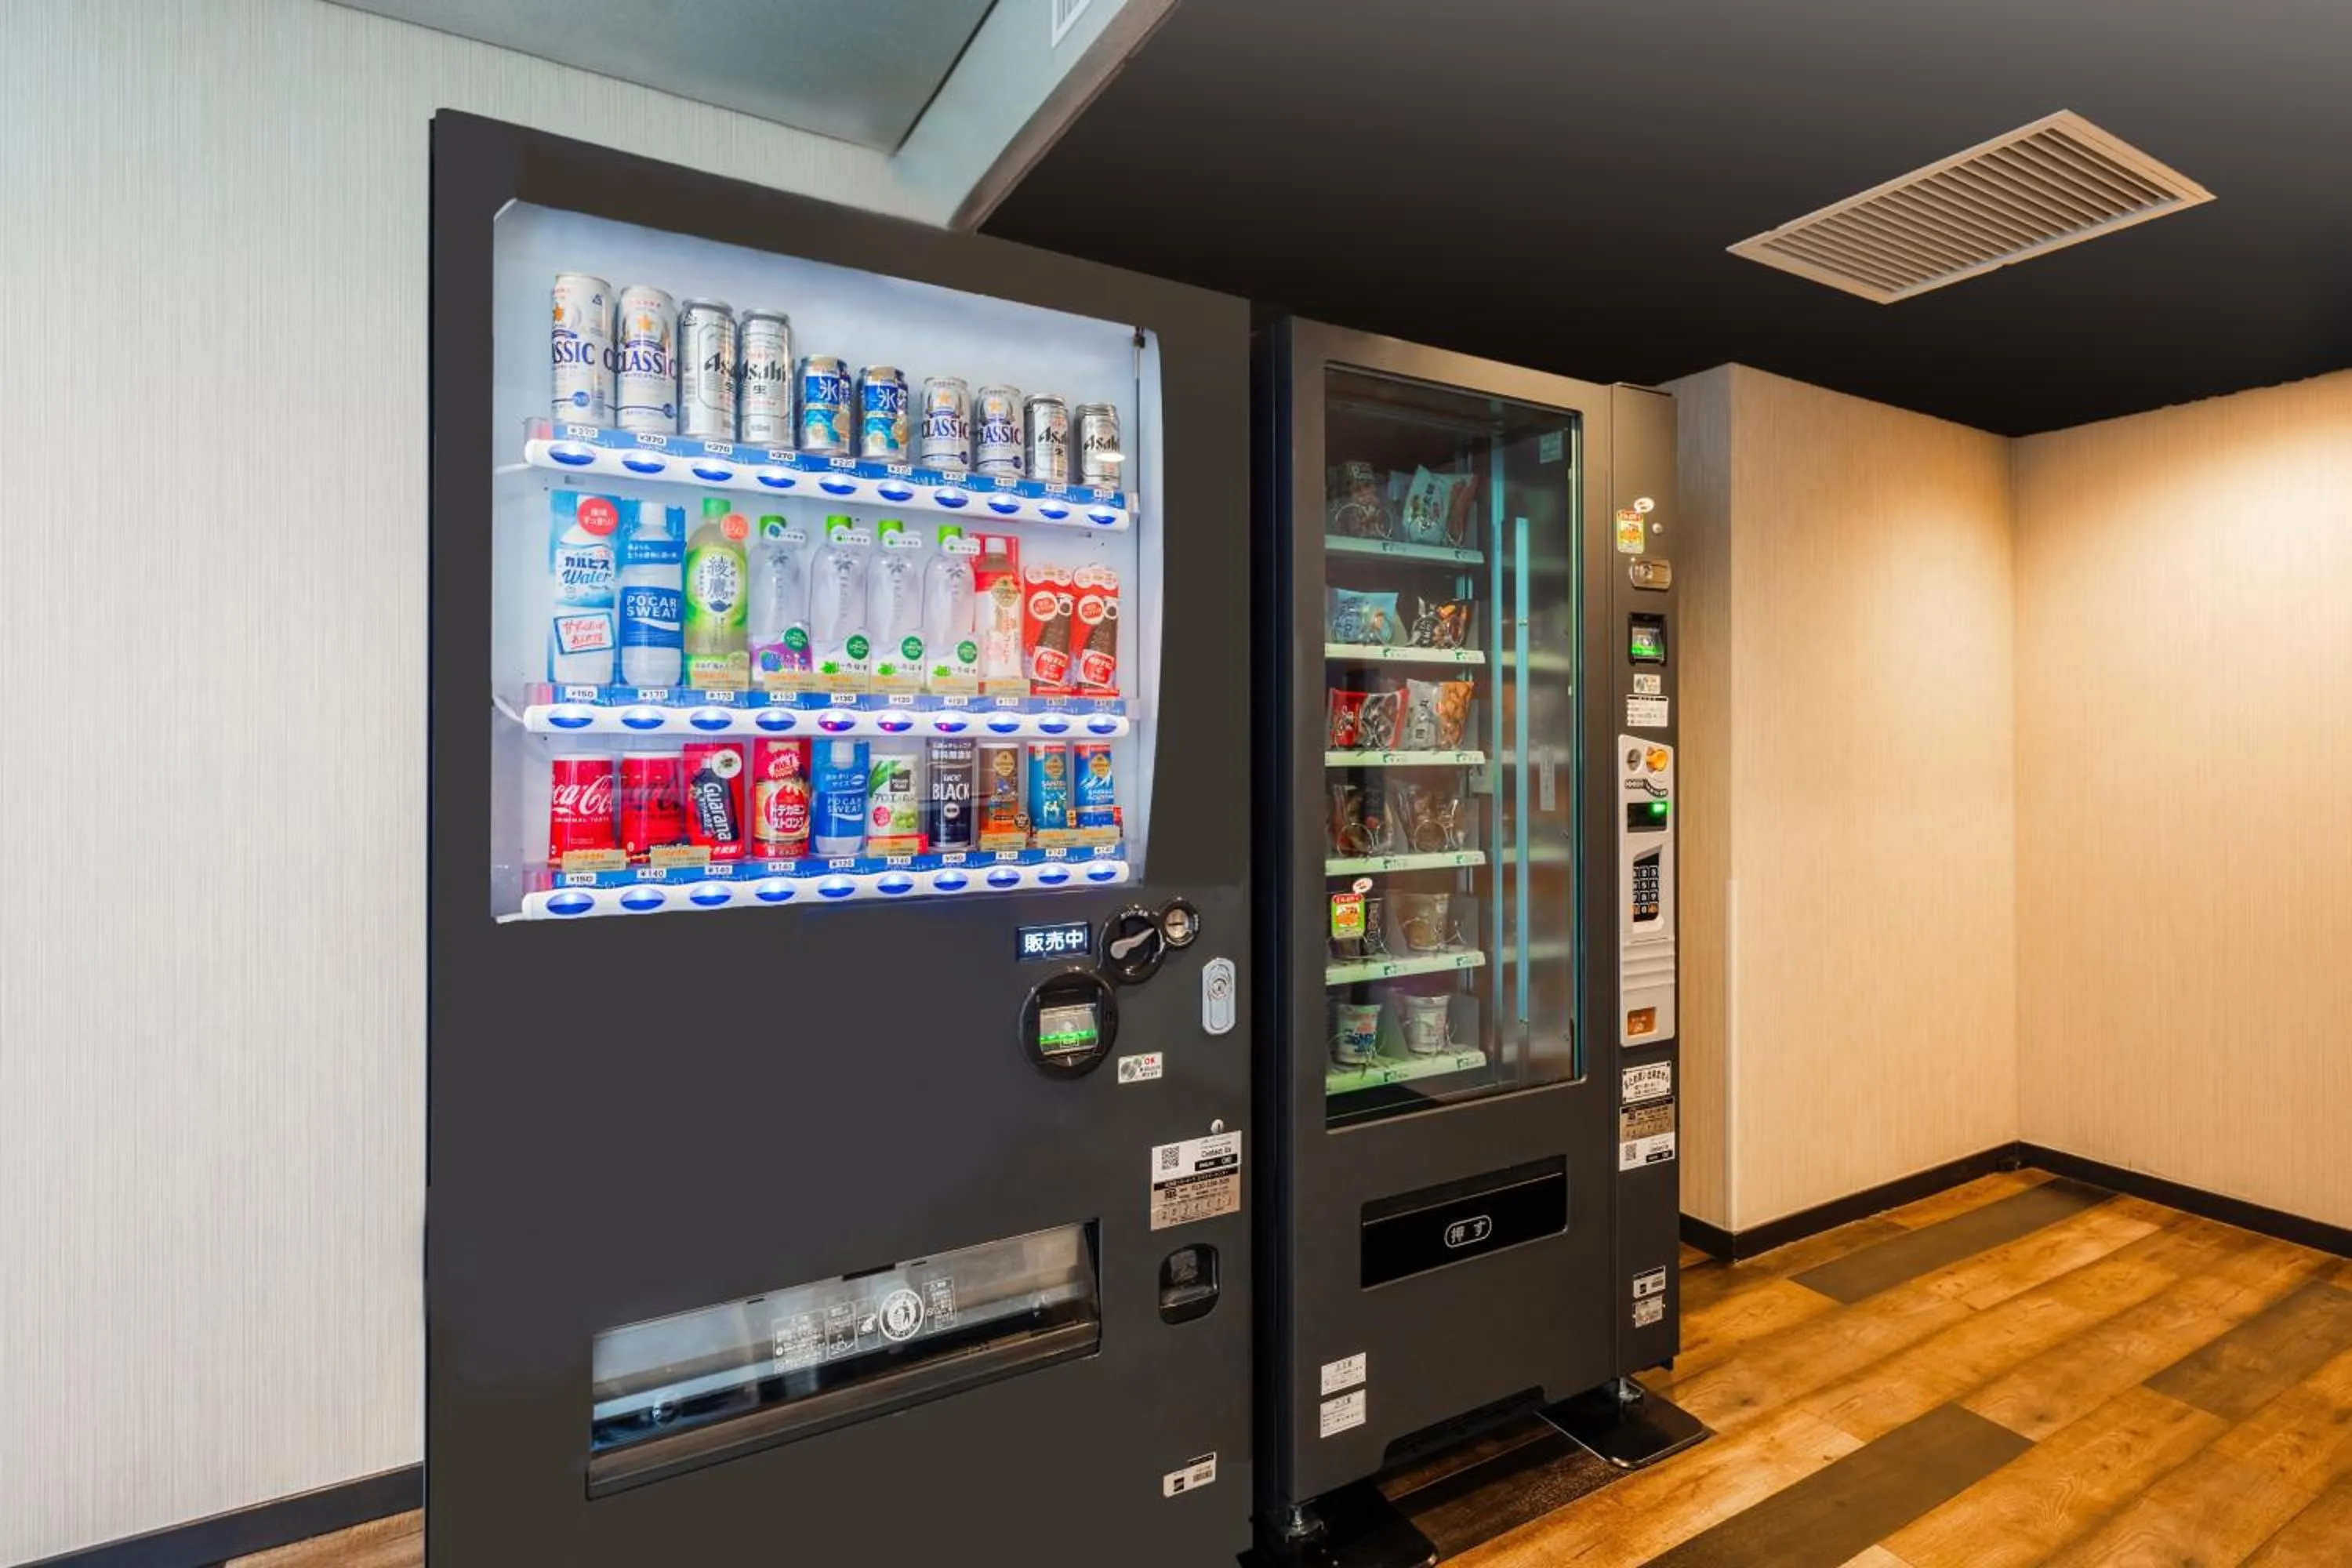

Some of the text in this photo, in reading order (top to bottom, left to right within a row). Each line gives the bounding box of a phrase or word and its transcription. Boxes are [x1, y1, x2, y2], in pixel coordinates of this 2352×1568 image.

[921, 417, 971, 440] CLASSIC
[564, 556, 610, 571] カルピス
[562, 568, 612, 586] Water
[626, 594, 677, 608] POCAR
[626, 606, 677, 619] SWEAT
[933, 783, 970, 800] BLACK
[703, 782, 731, 841] Guarana
[1024, 929, 1083, 953] 販売中
[1450, 1220, 1486, 1244] 押す
